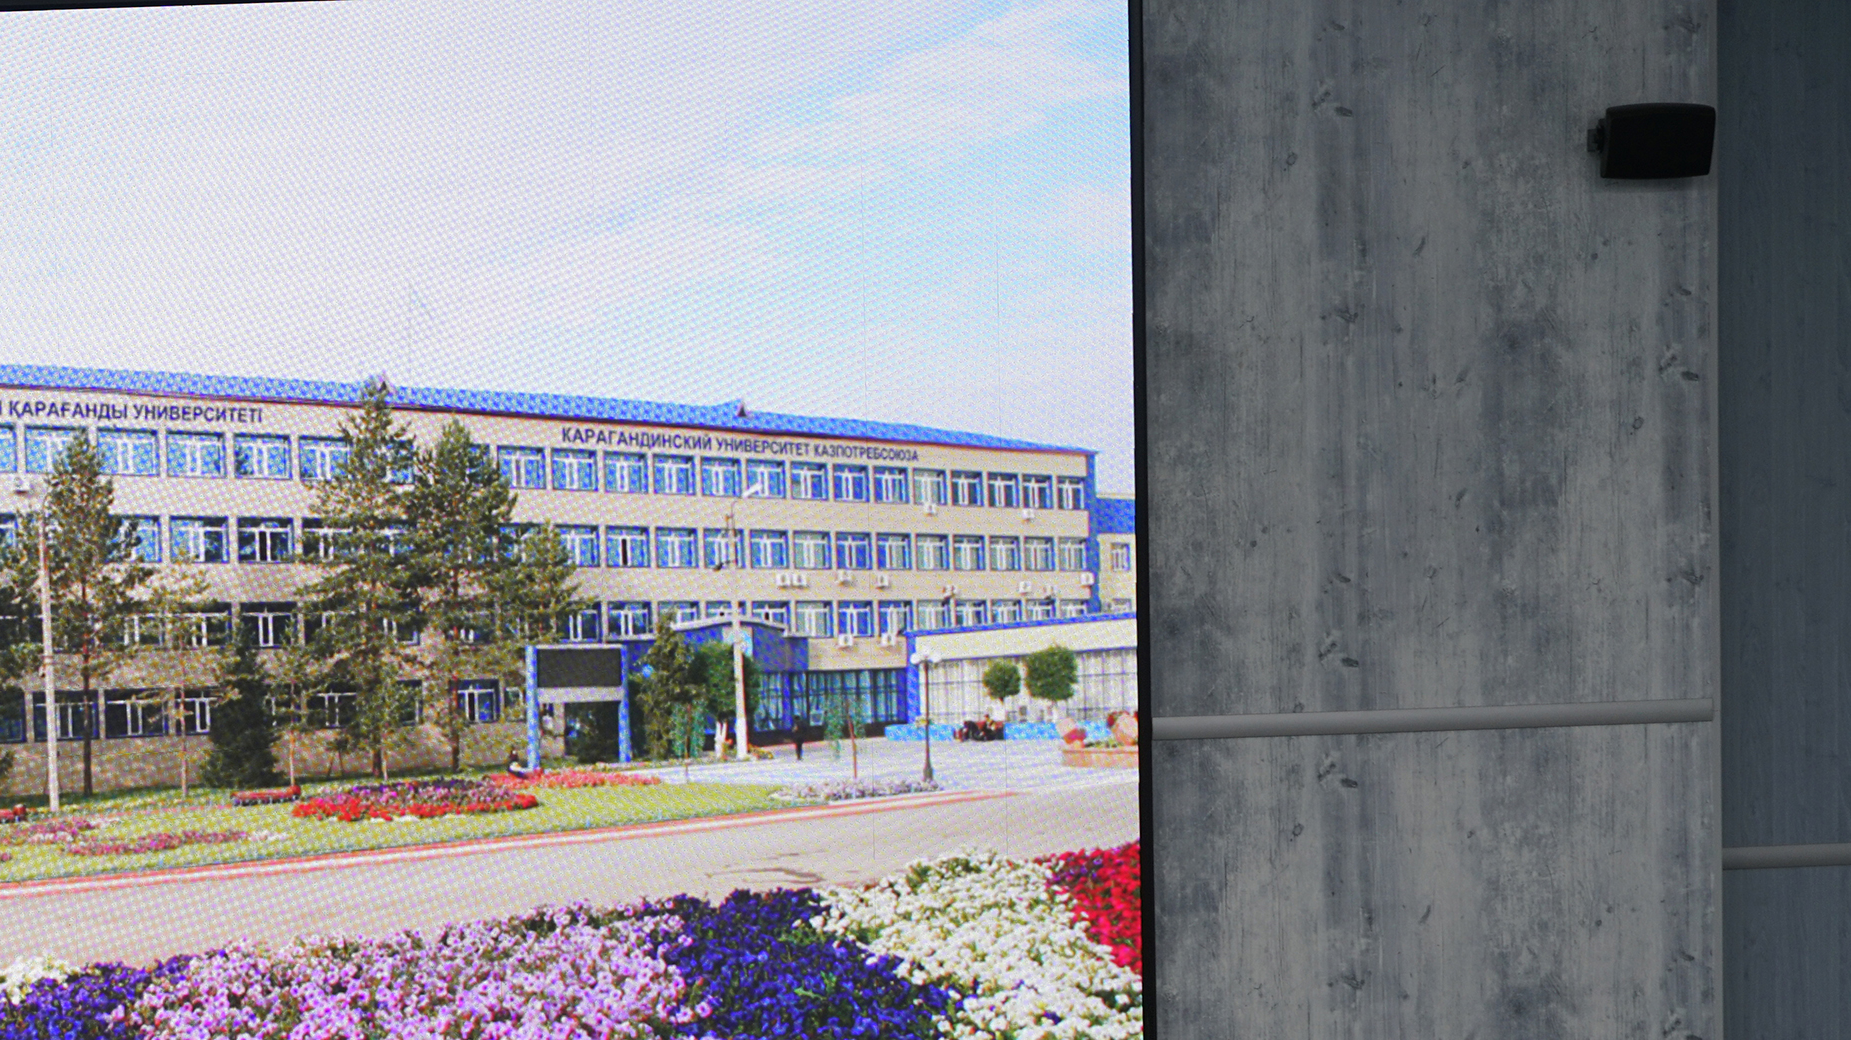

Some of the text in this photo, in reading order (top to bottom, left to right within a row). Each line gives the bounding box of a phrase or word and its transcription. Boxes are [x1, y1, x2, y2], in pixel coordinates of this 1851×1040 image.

[9, 400, 128, 421] ҚАРАҒАНДЫ
[132, 403, 263, 423] УНИВЕРСИТЕТІ
[561, 427, 919, 462] КАРАГАНДИНСКИЙ УНИВЕРСИТЕТ КАЗПОТРЕБСОЮЗА
